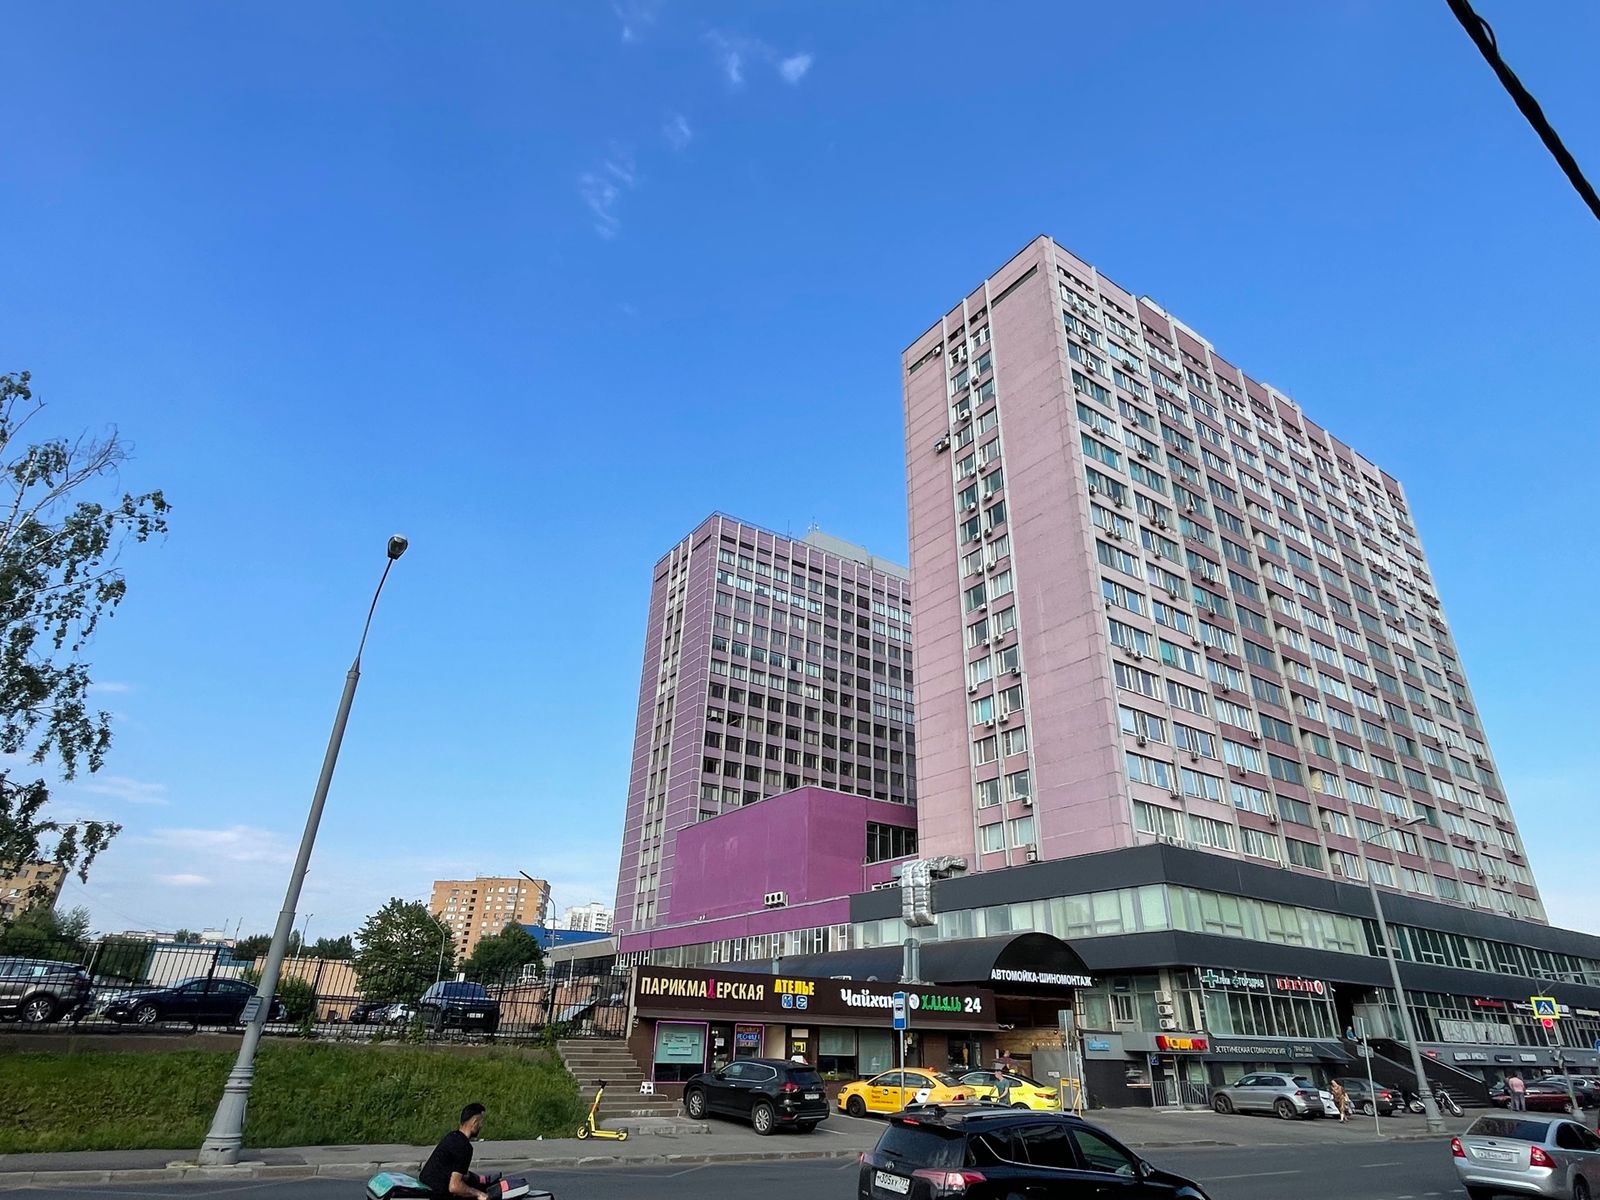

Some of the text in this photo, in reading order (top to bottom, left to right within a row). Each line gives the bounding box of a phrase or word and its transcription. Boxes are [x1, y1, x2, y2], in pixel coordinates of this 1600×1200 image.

[991, 968, 1093, 987] АВТОМОЙКА-ШИНОМОНТАЖ
[774, 978, 815, 996] АТЕЛЬЕ
[964, 997, 982, 1013] 24
